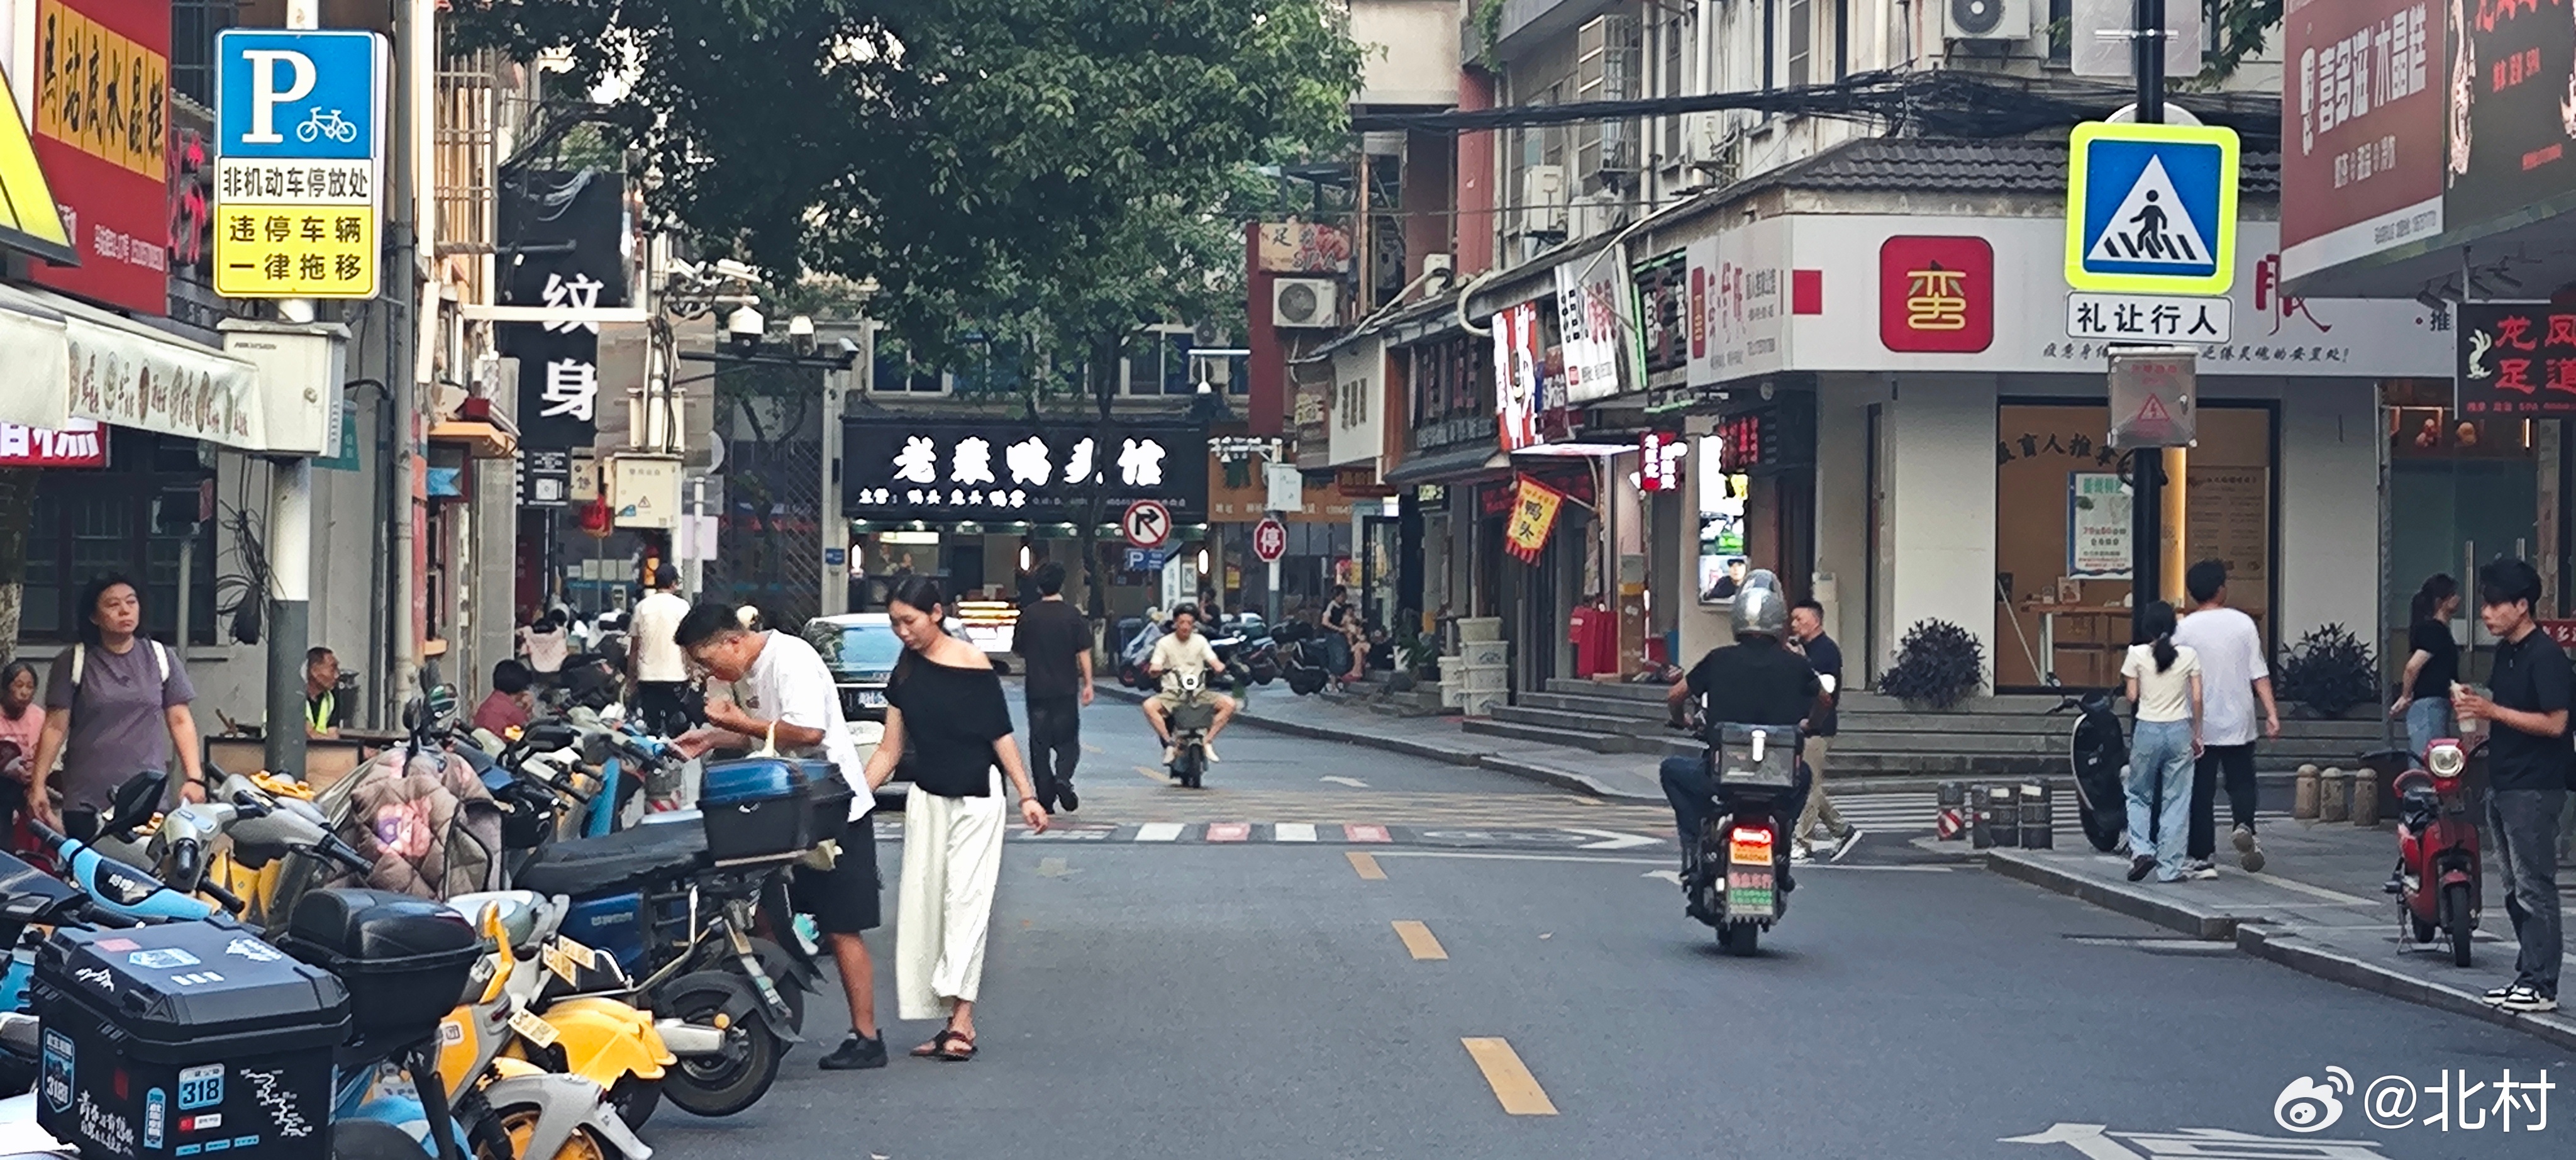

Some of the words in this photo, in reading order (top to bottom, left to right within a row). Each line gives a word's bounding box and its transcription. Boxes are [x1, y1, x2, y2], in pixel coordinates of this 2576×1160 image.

[242, 50, 316, 143] P
[223, 167, 369, 199] 非机动车停放处
[230, 216, 361, 242] 违停车辆
[230, 254, 361, 281] 一律拖移
[2077, 303, 2218, 335] 礼让行人
[541, 273, 604, 421] 纹身
[1519, 499, 1543, 541] 鸭头
[1260, 527, 1281, 554] 停
[1130, 552, 1144, 567] P
[183, 1078, 219, 1105] 318
